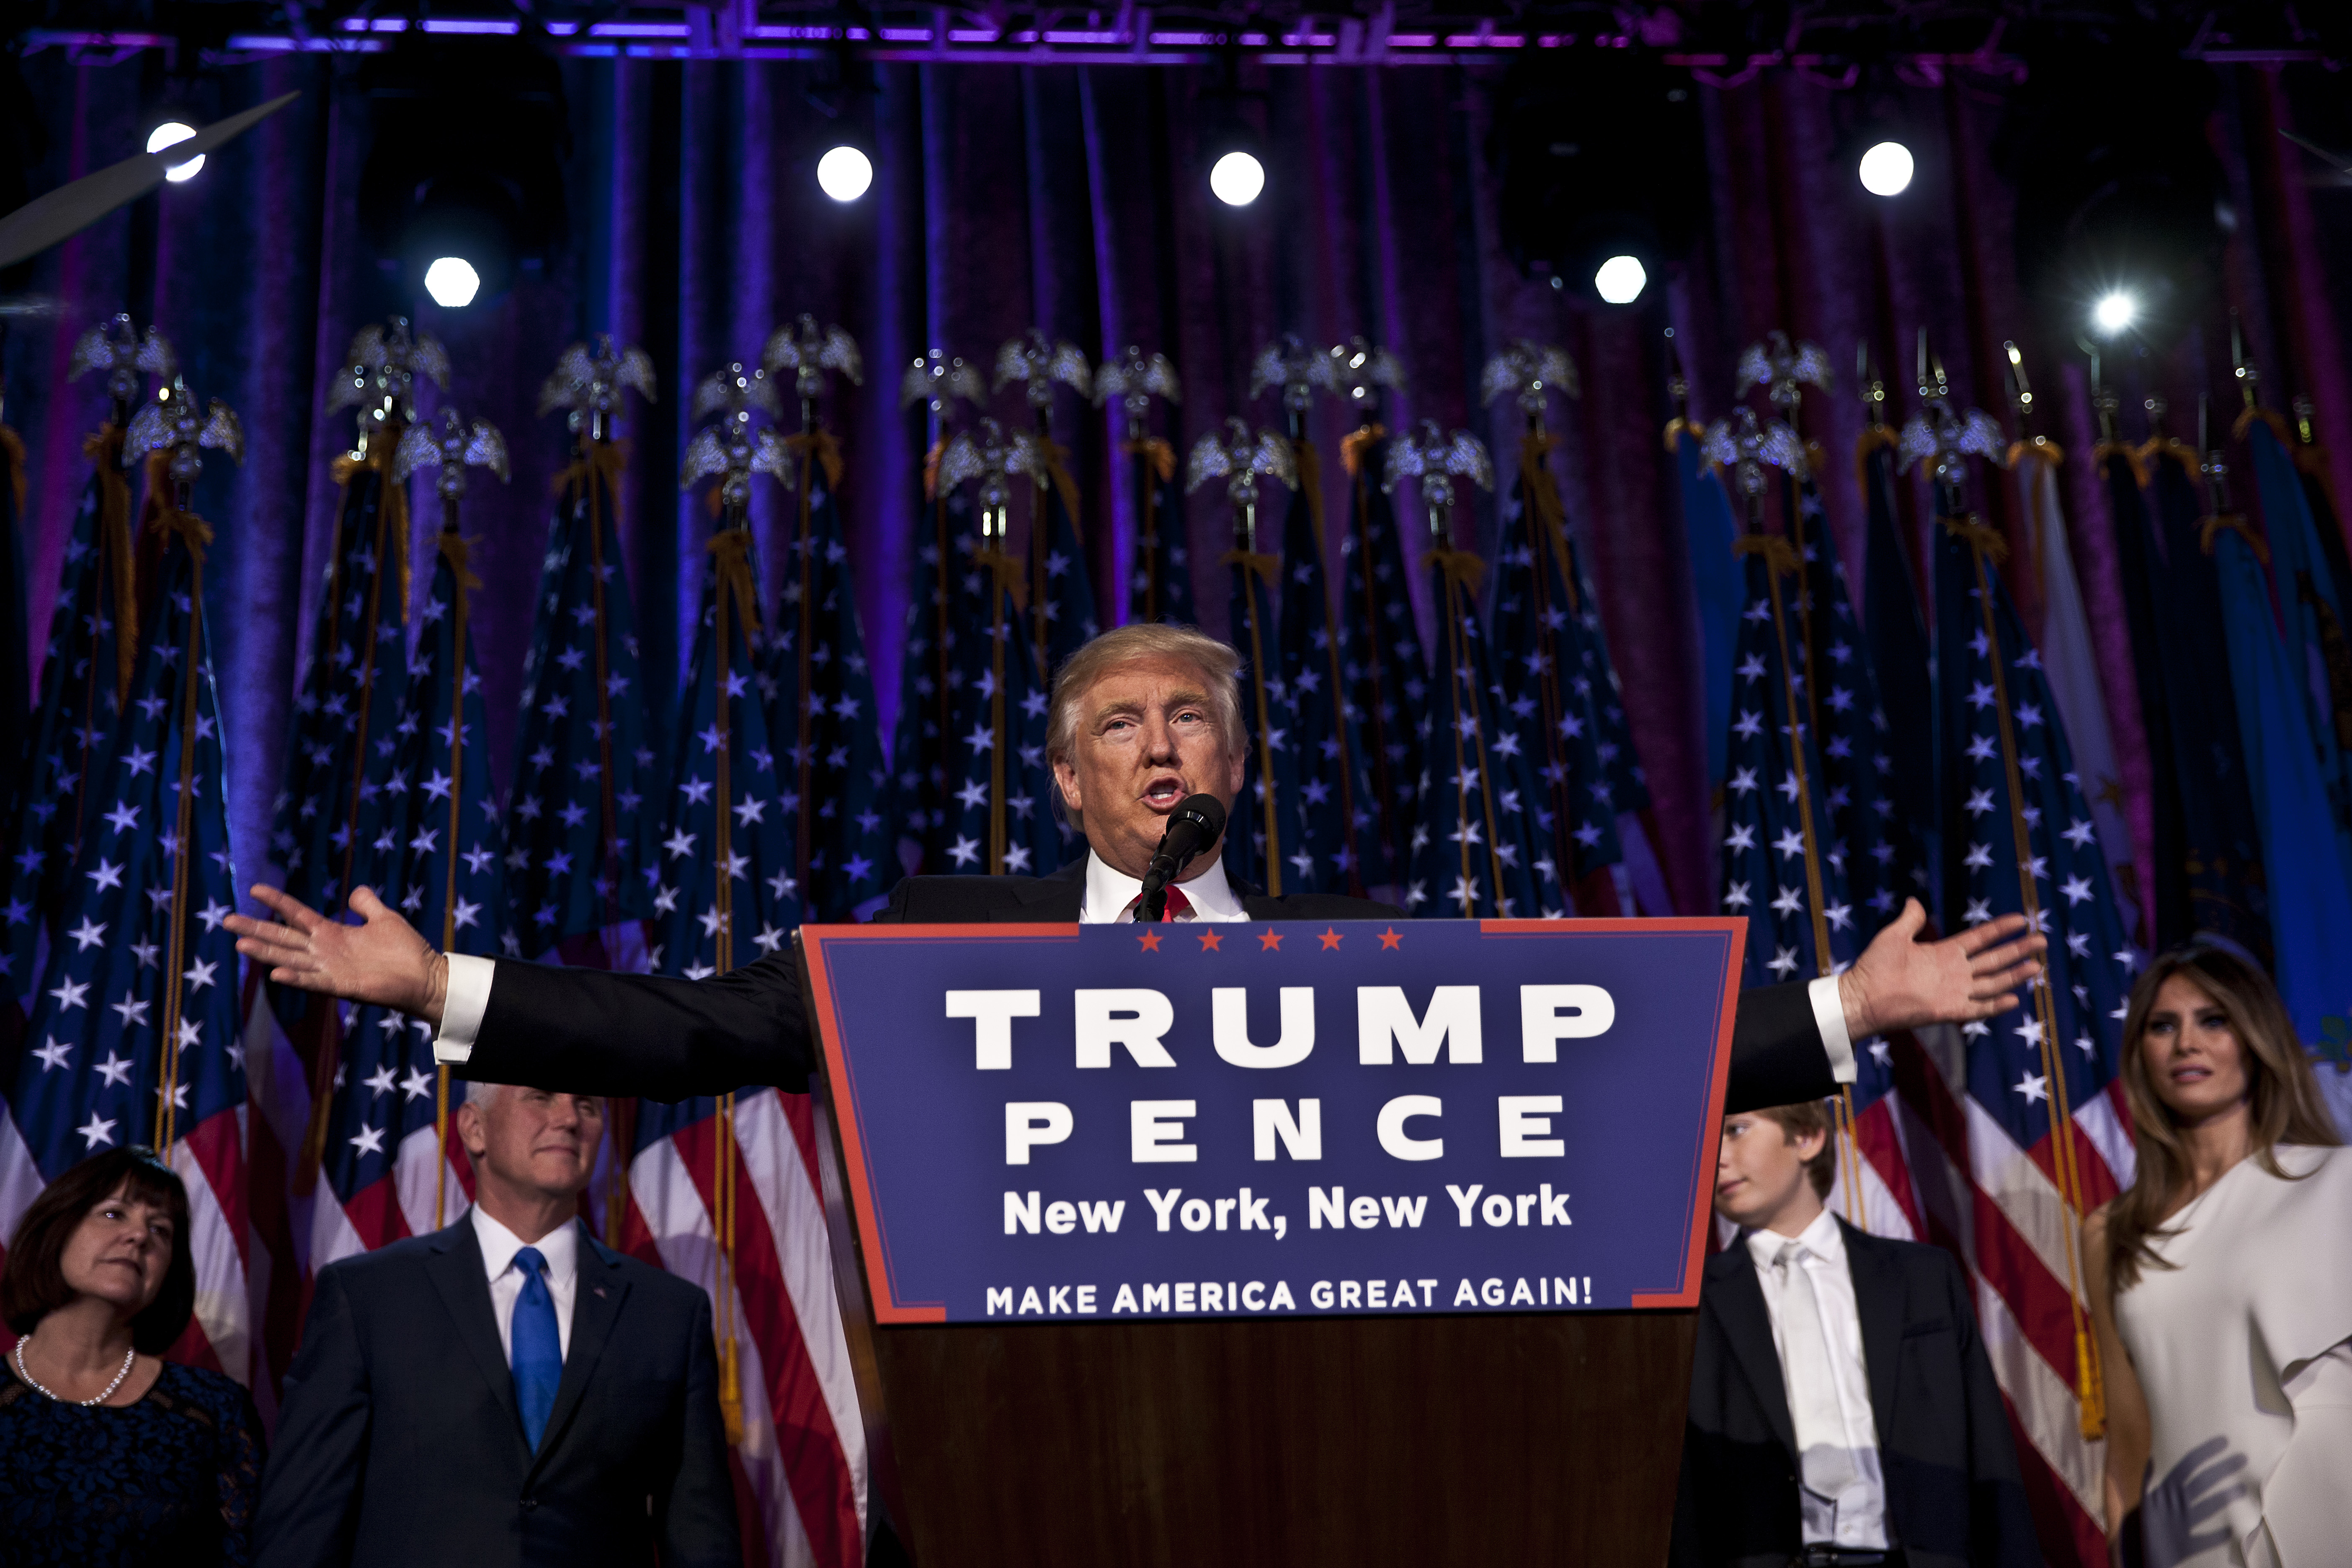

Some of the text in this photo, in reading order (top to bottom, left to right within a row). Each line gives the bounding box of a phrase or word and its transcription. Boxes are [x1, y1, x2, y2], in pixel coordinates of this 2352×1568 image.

[945, 984, 1615, 1070] TRUMP
[1005, 1094, 1565, 1165] PENCE
[1003, 1183, 1572, 1240] New York, New York
[986, 1276, 1592, 1316] MAKE AMERICA GREAT AGAIN!
